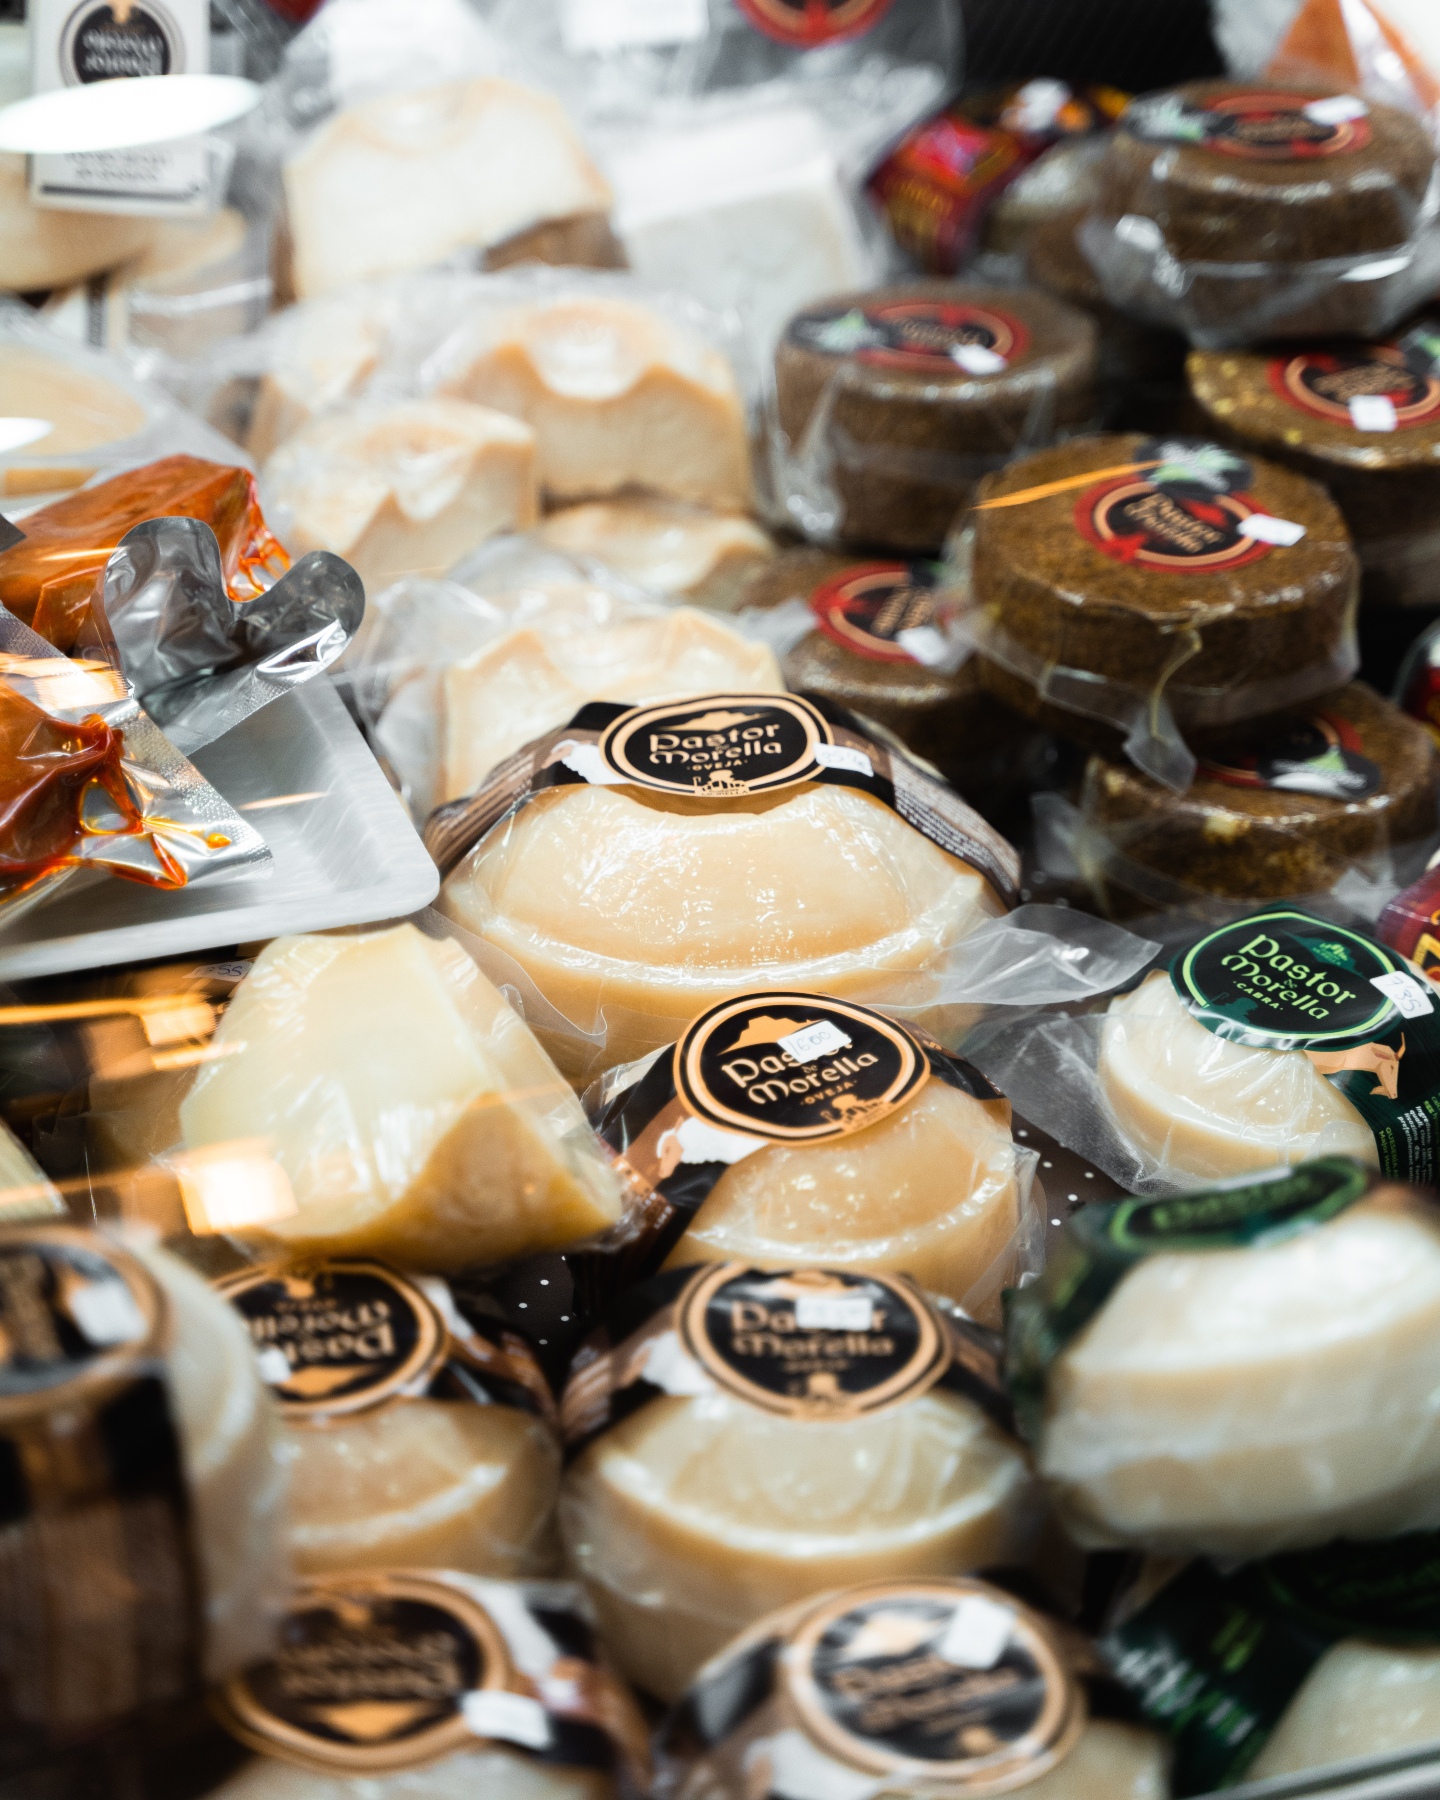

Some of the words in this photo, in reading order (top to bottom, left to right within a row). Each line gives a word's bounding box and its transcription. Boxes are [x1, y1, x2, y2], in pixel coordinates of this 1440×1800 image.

[649, 724, 780, 752] Pastor
[649, 740, 782, 764] Morella
[692, 759, 743, 771] OVEJA
[1238, 934, 1356, 1004] Pastor
[1221, 954, 1330, 1020] Morella
[1236, 981, 1280, 1010] CABRA
[748, 1053, 879, 1104] Morella
[804, 1081, 856, 1105] OVEJA
[731, 1300, 888, 1332] Par
